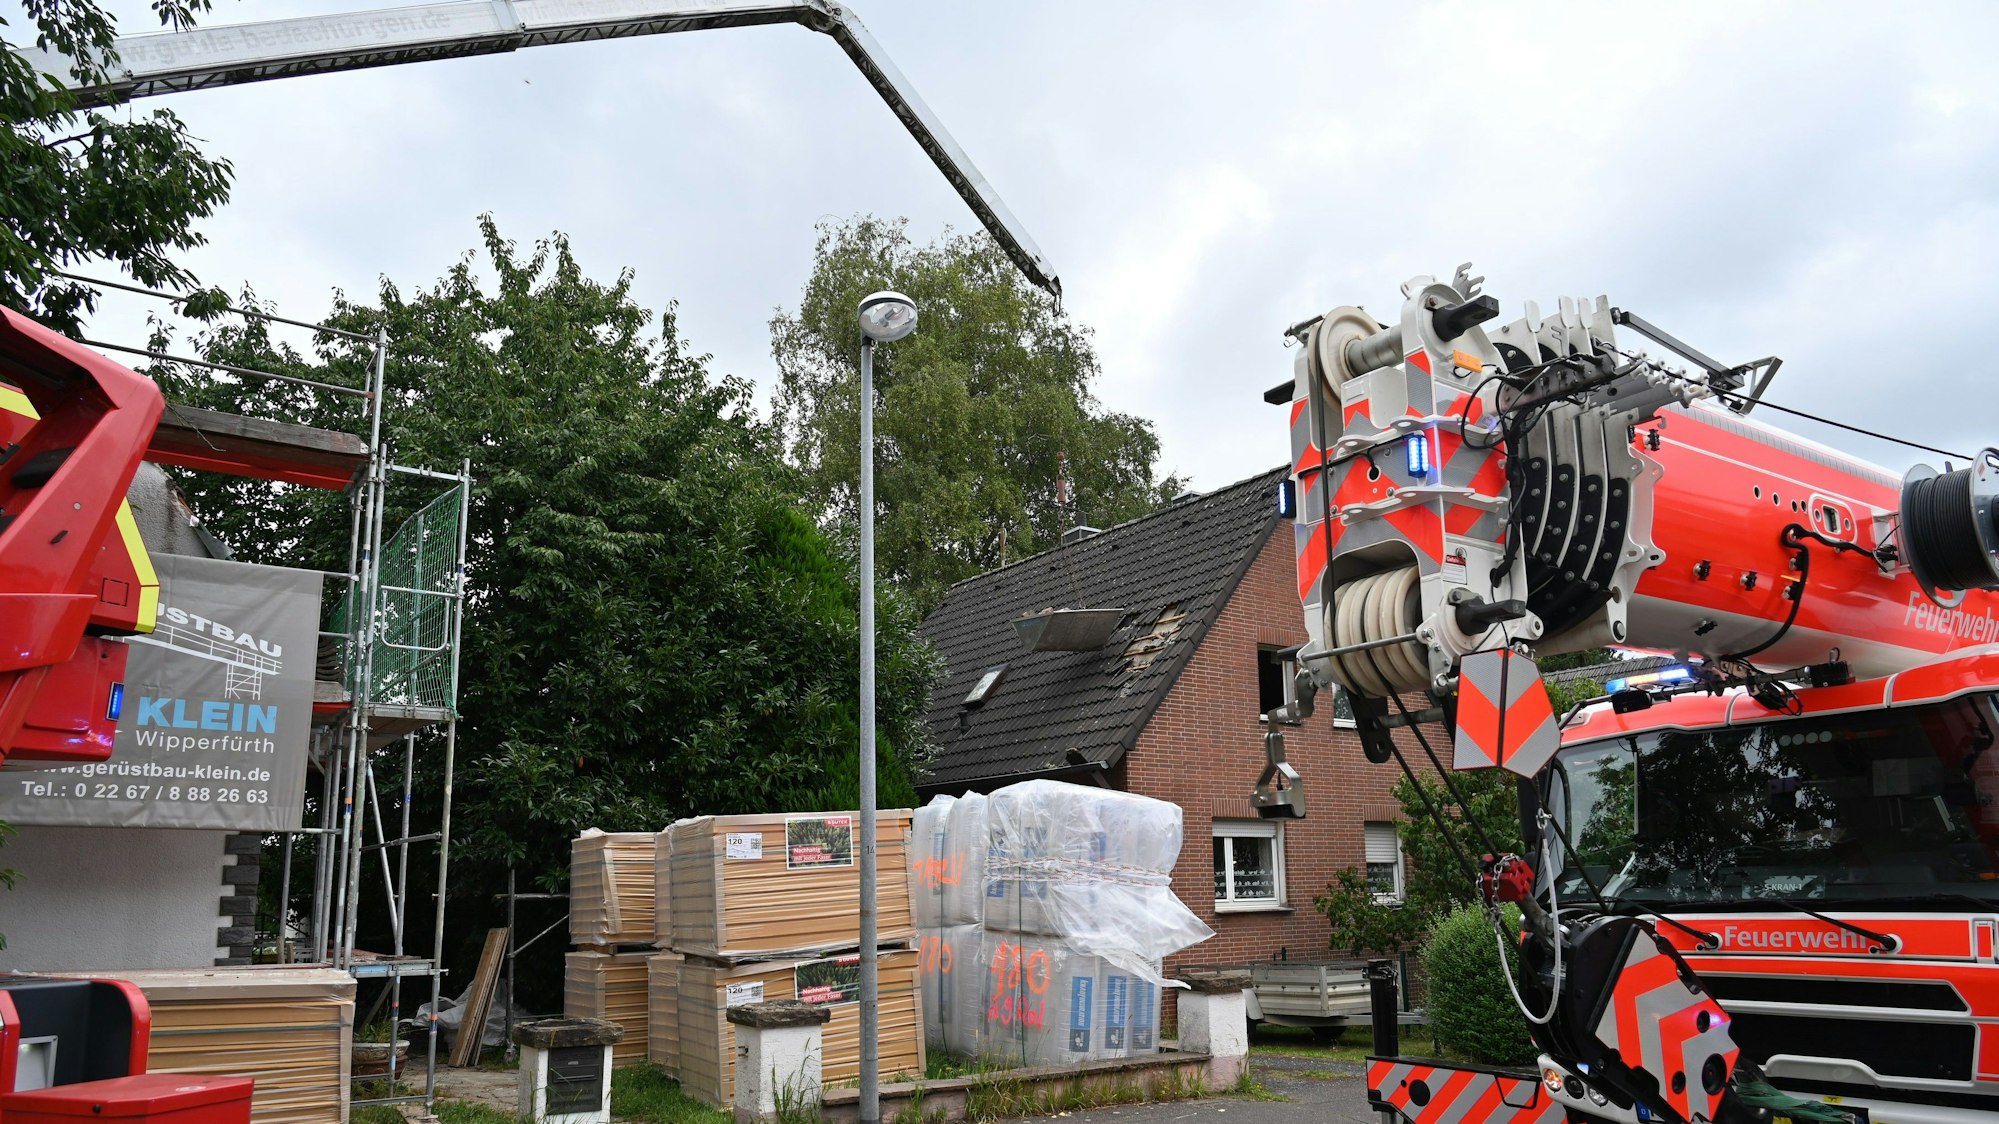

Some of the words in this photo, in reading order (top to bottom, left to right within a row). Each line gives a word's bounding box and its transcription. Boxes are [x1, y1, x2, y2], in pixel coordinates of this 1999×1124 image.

[137, 696, 278, 733] KLEIN
[136, 730, 275, 754] Wipperfürth
[21, 780, 67, 797] Tel.:
[75, 783, 87, 797] 0
[94, 783, 119, 799] 22
[126, 785, 150, 800] 67
[155, 785, 163, 800] /
[169, 785, 181, 801] 8
[187, 786, 210, 801] 88
[217, 787, 240, 802] 26
[246, 788, 269, 804] 63
[793, 846, 821, 854] Nachhaltig
[990, 941, 1051, 997] 180
[728, 987, 743, 995] 120
[803, 986, 831, 995] Nachhaltig
